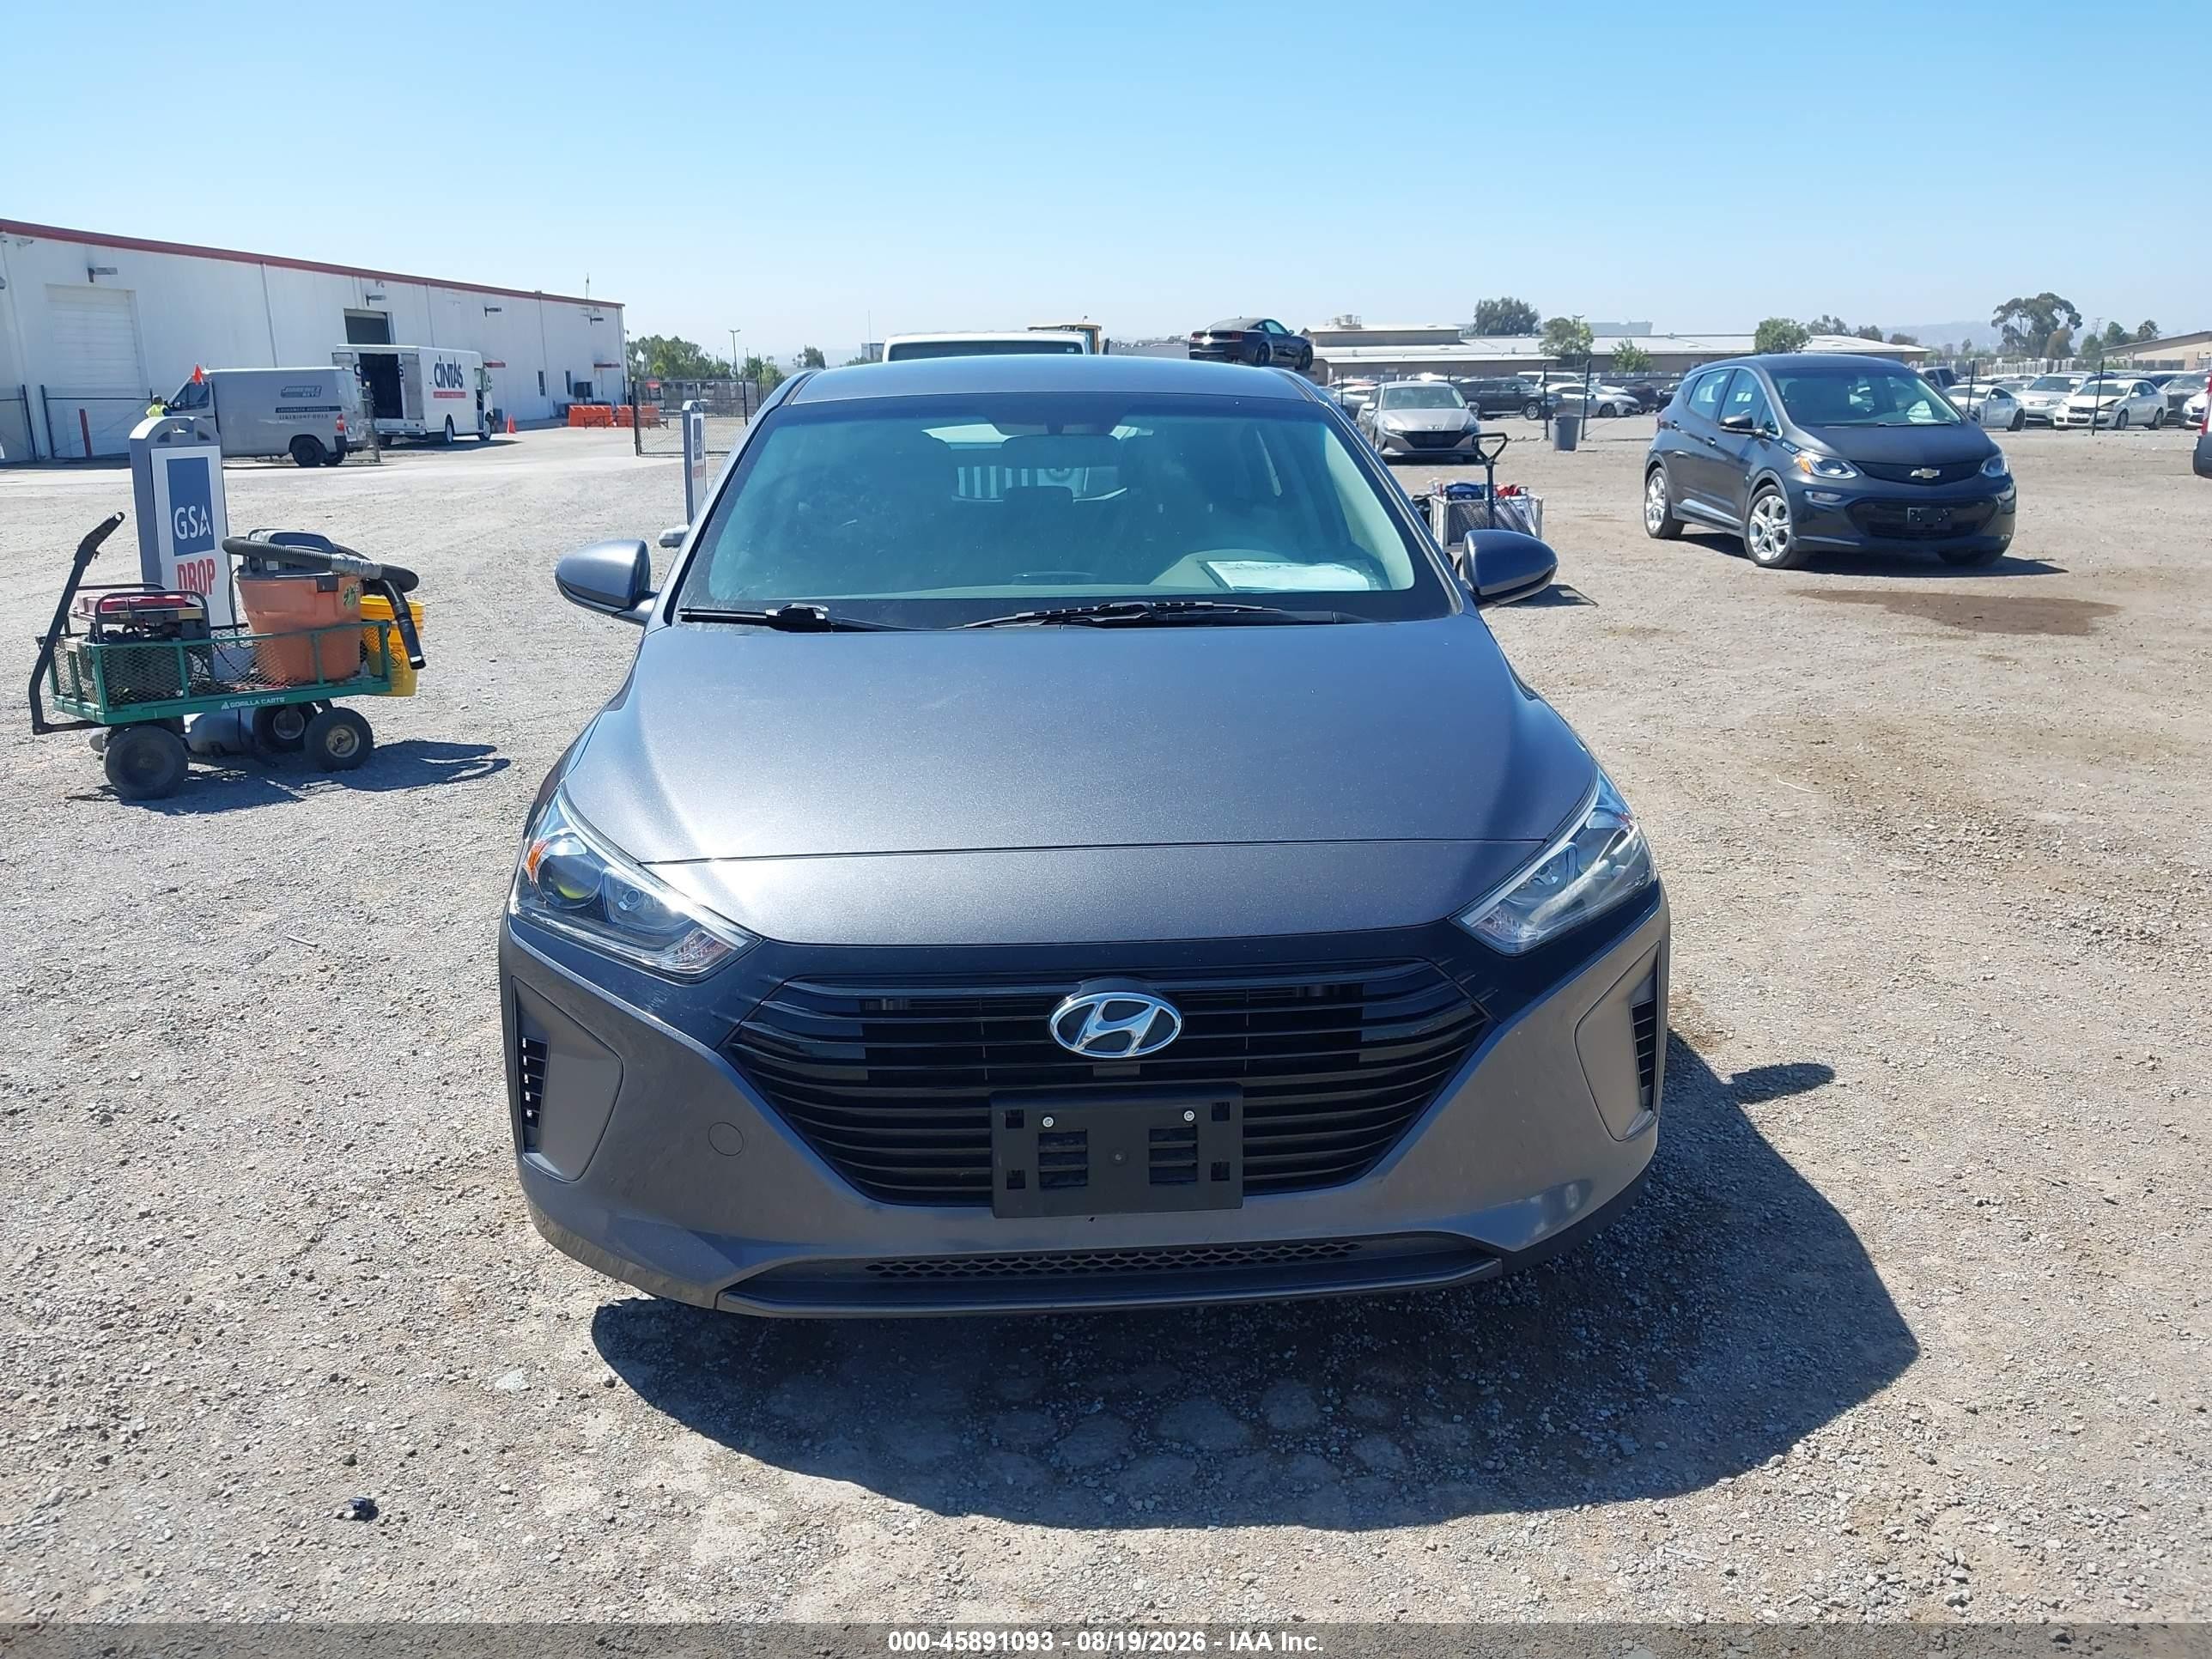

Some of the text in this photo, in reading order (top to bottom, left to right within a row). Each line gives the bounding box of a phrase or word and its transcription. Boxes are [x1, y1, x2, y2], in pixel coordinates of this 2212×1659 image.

[434, 355, 464, 389] CINTAS
[173, 504, 212, 540] GSA
[177, 558, 216, 598] DROP
